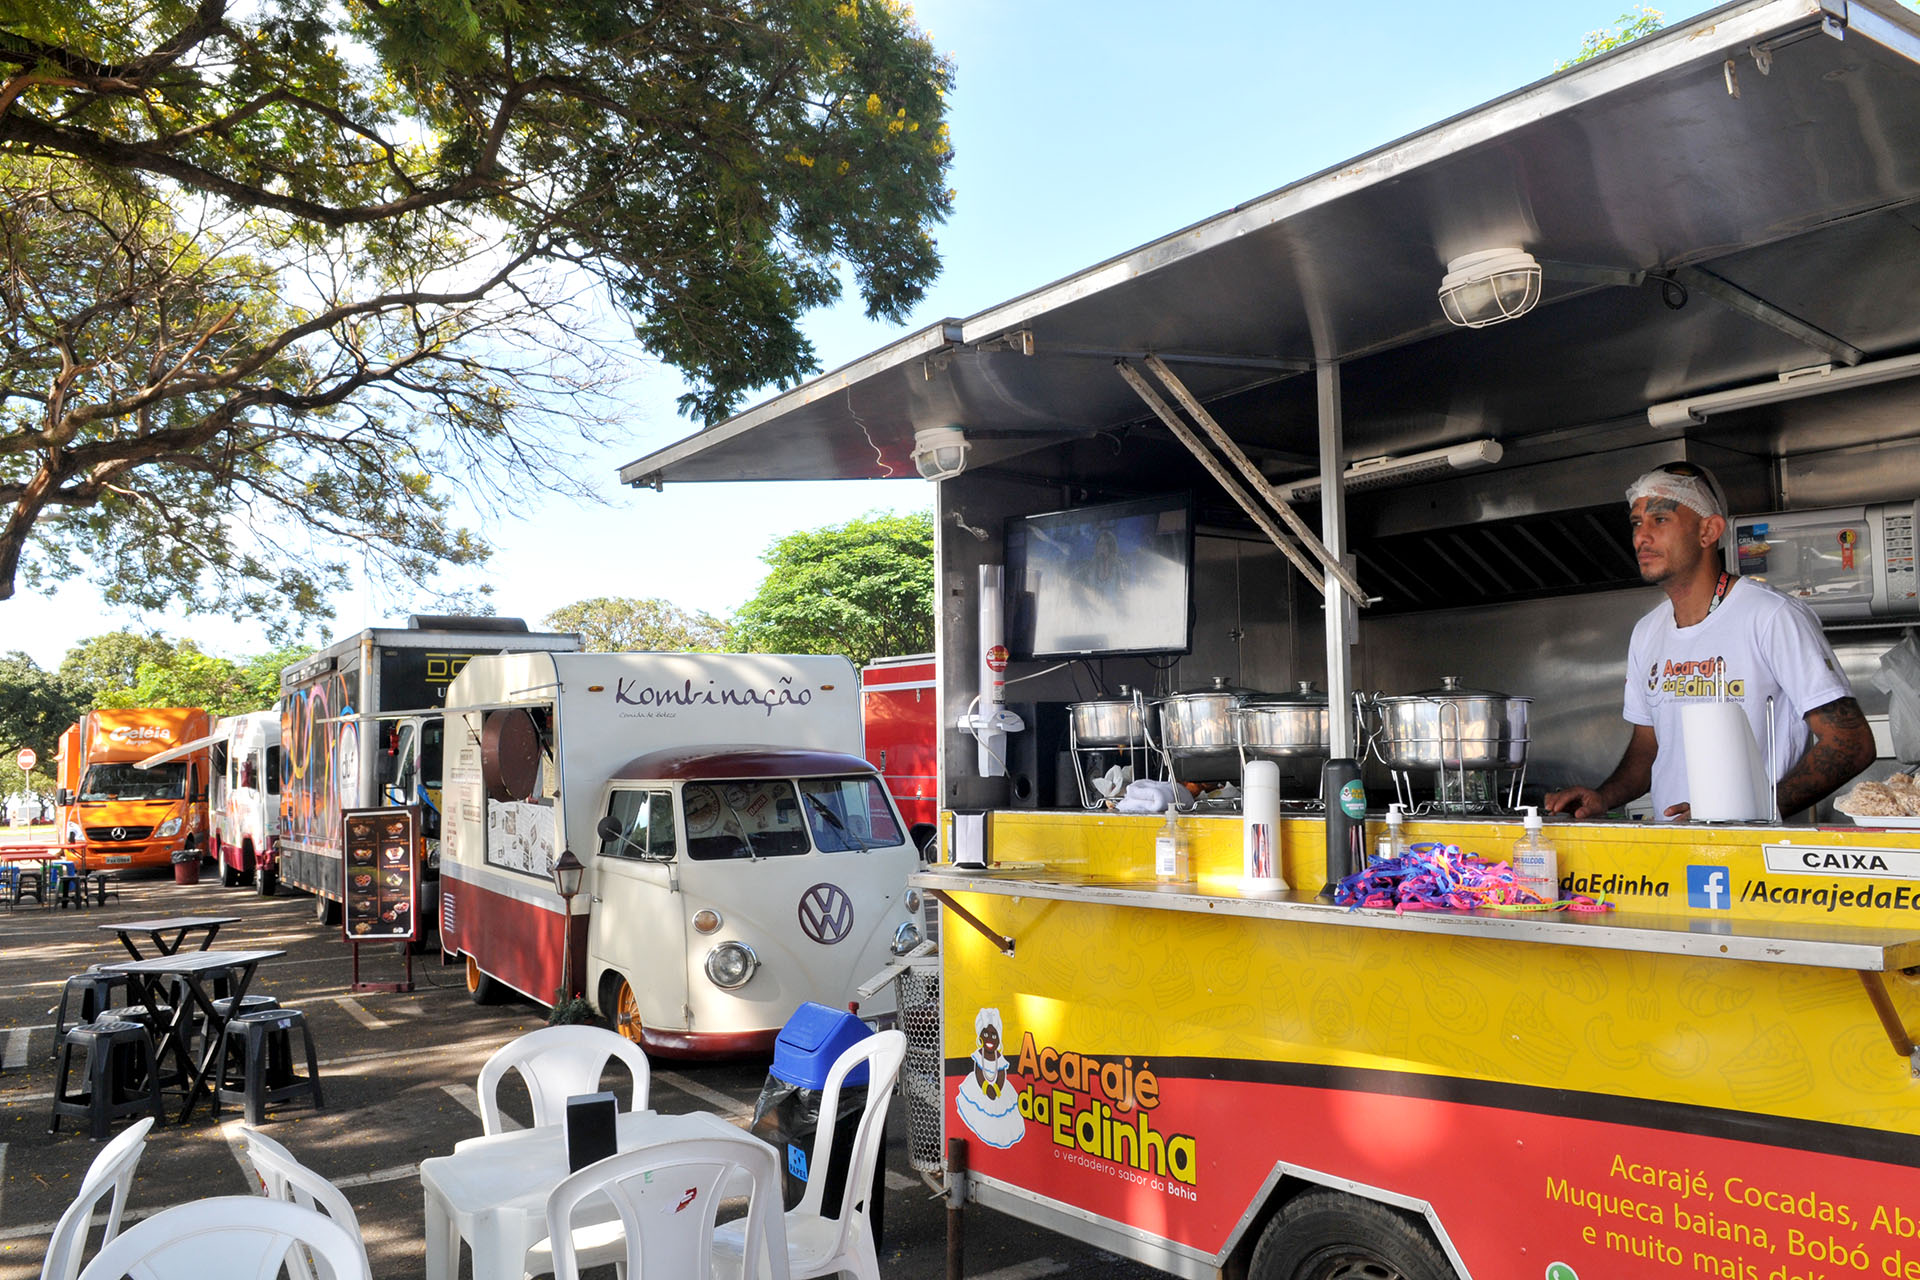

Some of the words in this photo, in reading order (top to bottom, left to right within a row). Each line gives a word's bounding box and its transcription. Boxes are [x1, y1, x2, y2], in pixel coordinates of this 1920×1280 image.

[616, 676, 812, 717] Kombinação
[1557, 871, 1670, 897] daEdinha
[1802, 853, 1889, 871] CAIXA
[1017, 1031, 1160, 1114] Acarajé
[1017, 1083, 1051, 1126] da
[1051, 1087, 1197, 1186] Edinha
[789, 1163, 808, 1180] PAPEL
[1054, 1149, 1060, 1158] o
[1062, 1151, 1116, 1176] verdadeiro
[1118, 1168, 1148, 1186] sabor
[1151, 1178, 1165, 1191] da
[1168, 1181, 1198, 1202] Bahia
[1610, 1154, 1715, 1201] Acarajé,
[1724, 1177, 1859, 1231] Cocadas,
[1870, 1204, 1920, 1239] Ab
[1546, 1176, 1664, 1225] Muqueca
[1674, 1203, 1776, 1254] baiana,
[1789, 1228, 1870, 1270] Bobó
[1881, 1250, 1920, 1280] de
[1582, 1226, 1597, 1245] e
[1606, 1230, 1683, 1267] muito
[1693, 1252, 1758, 1280] mais
